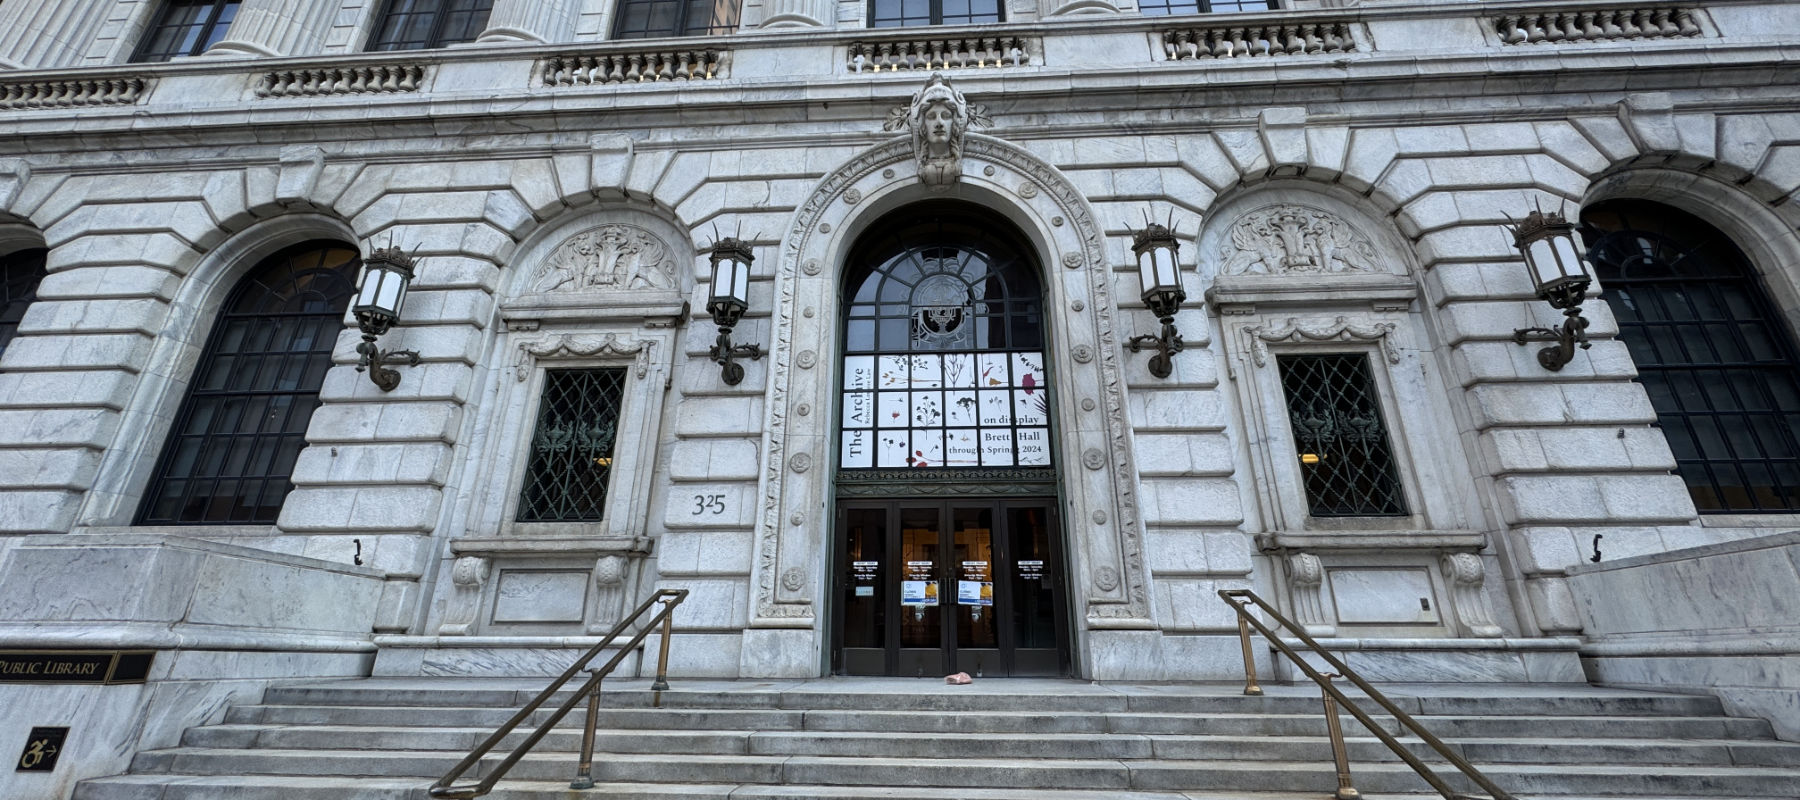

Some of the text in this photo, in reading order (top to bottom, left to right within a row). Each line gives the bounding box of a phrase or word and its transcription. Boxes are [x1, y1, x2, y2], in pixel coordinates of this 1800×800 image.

[849, 368, 863, 458] The Archive
[999, 415, 1039, 425] display
[985, 432, 1040, 441] Brett Hall
[949, 446, 984, 454] through
[1022, 445, 1042, 453] 2024
[692, 494, 726, 515] 325
[0, 660, 100, 674] PUBLIC LIBRARY
